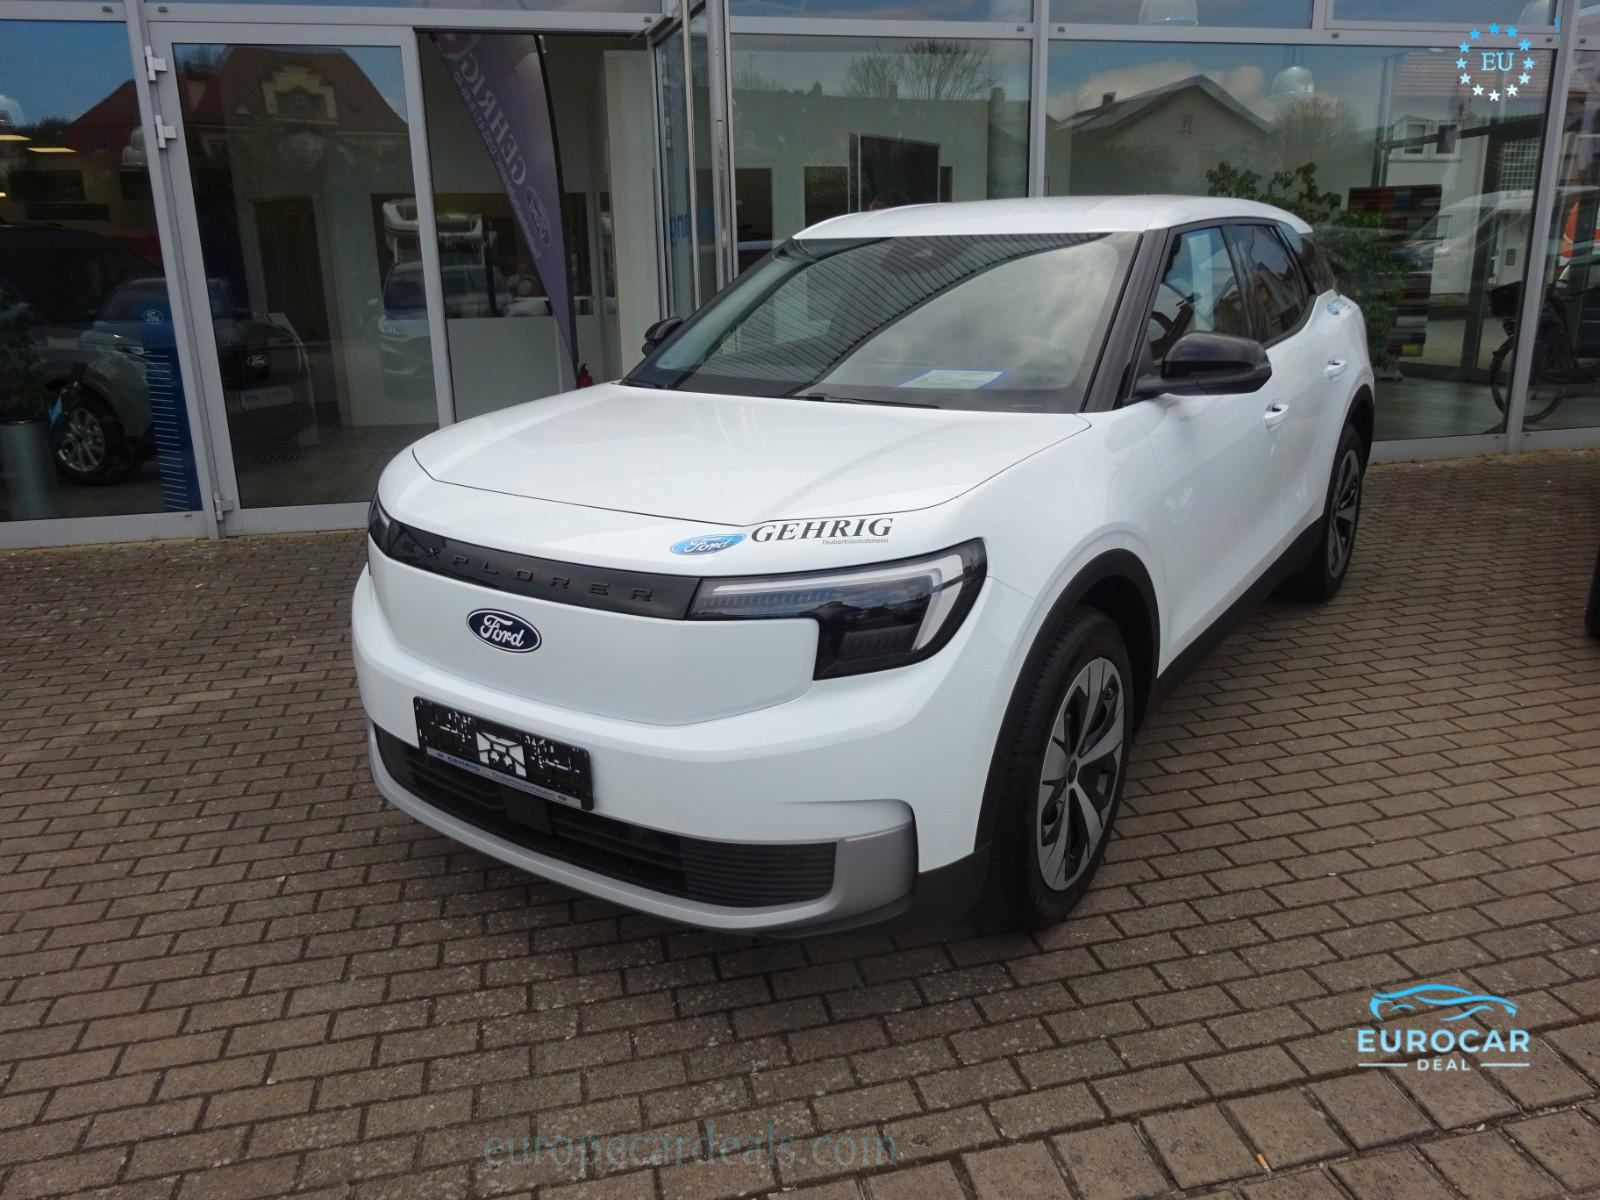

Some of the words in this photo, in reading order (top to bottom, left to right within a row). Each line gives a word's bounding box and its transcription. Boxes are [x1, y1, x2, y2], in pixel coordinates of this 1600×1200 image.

[683, 536, 732, 553] Ford
[752, 518, 893, 543] GEHRIG
[403, 541, 653, 602] EXPLORER
[479, 614, 525, 648] Ford
